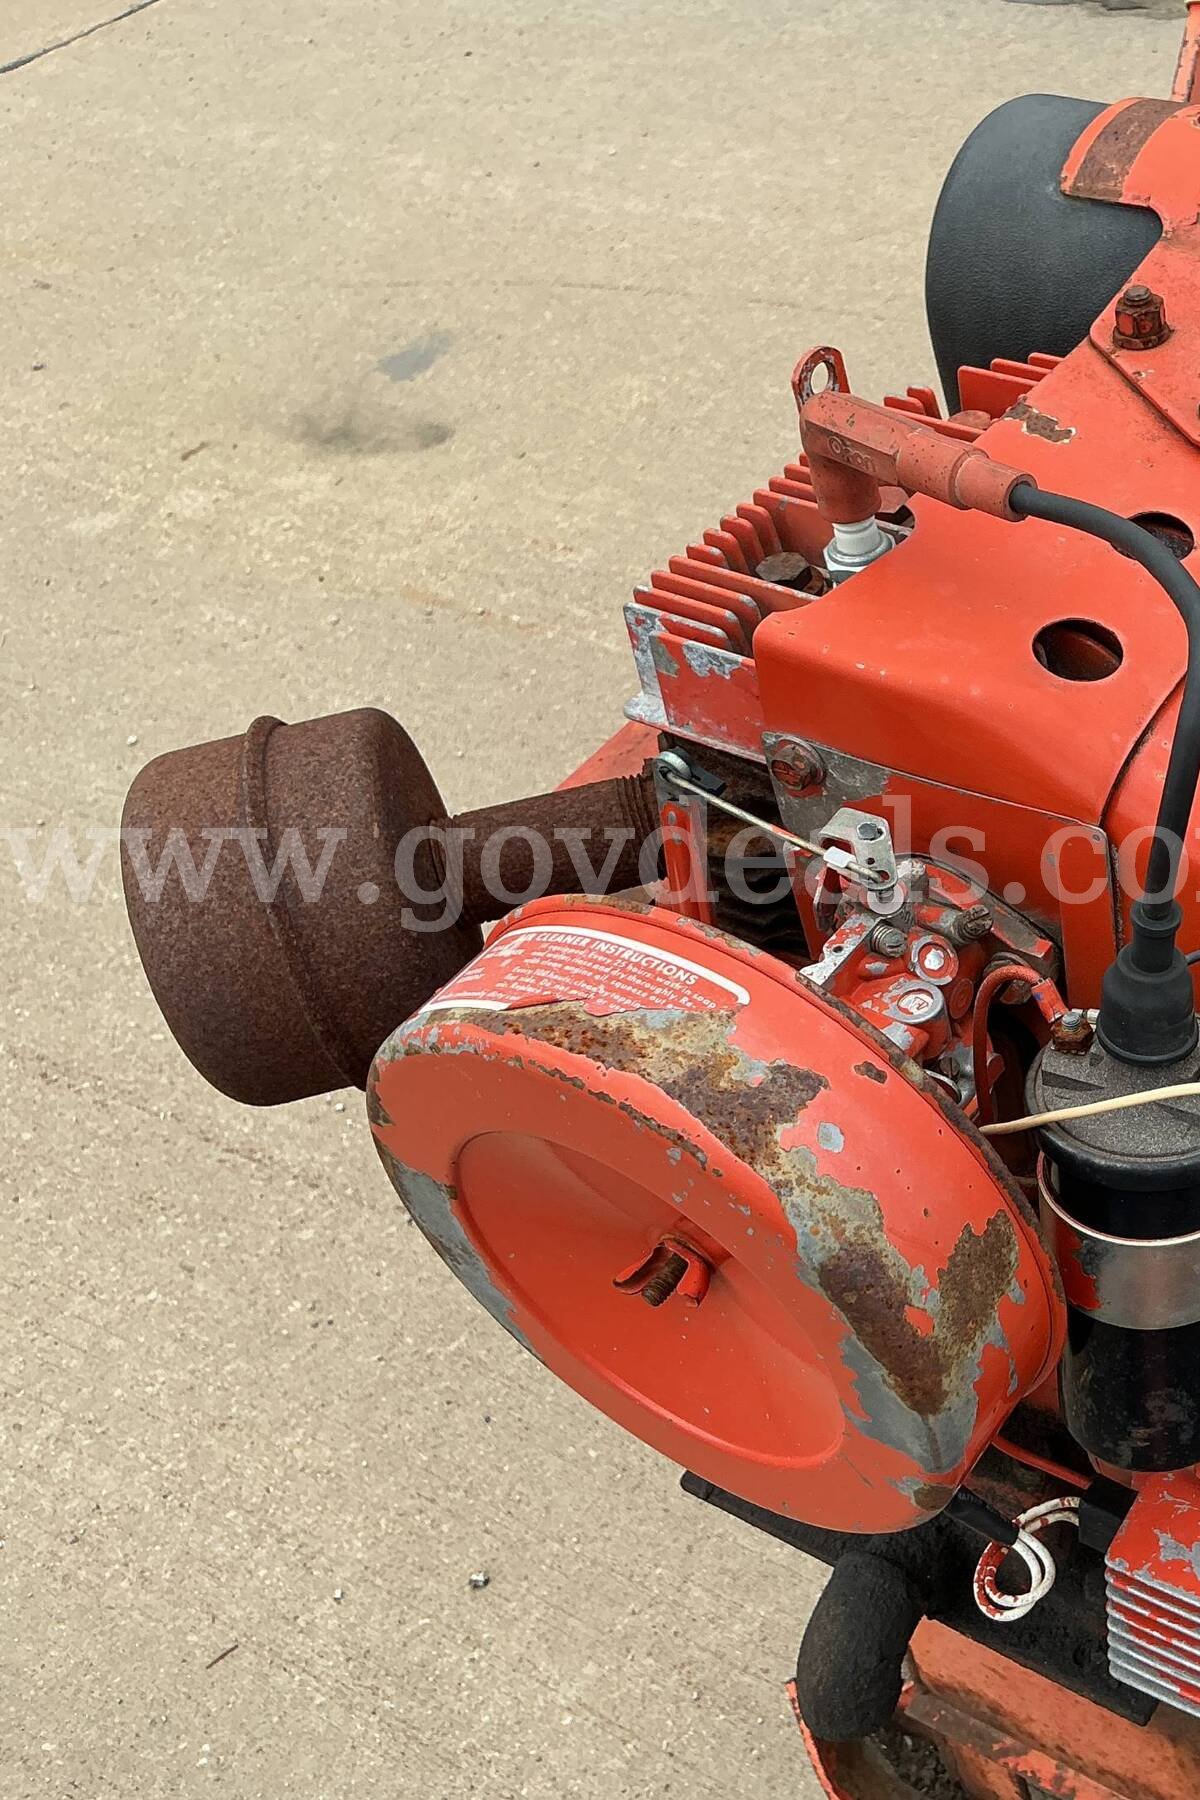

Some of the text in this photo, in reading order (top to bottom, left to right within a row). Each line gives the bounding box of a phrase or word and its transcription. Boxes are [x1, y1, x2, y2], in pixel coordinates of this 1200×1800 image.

[536, 932, 591, 947] CLEANER
[590, 939, 699, 985] INSTRUCTIONS
[610, 980, 648, 998] squeeze
[649, 995, 667, 1005] out
[610, 992, 645, 1008] tappin
[692, 992, 717, 1009] soap
